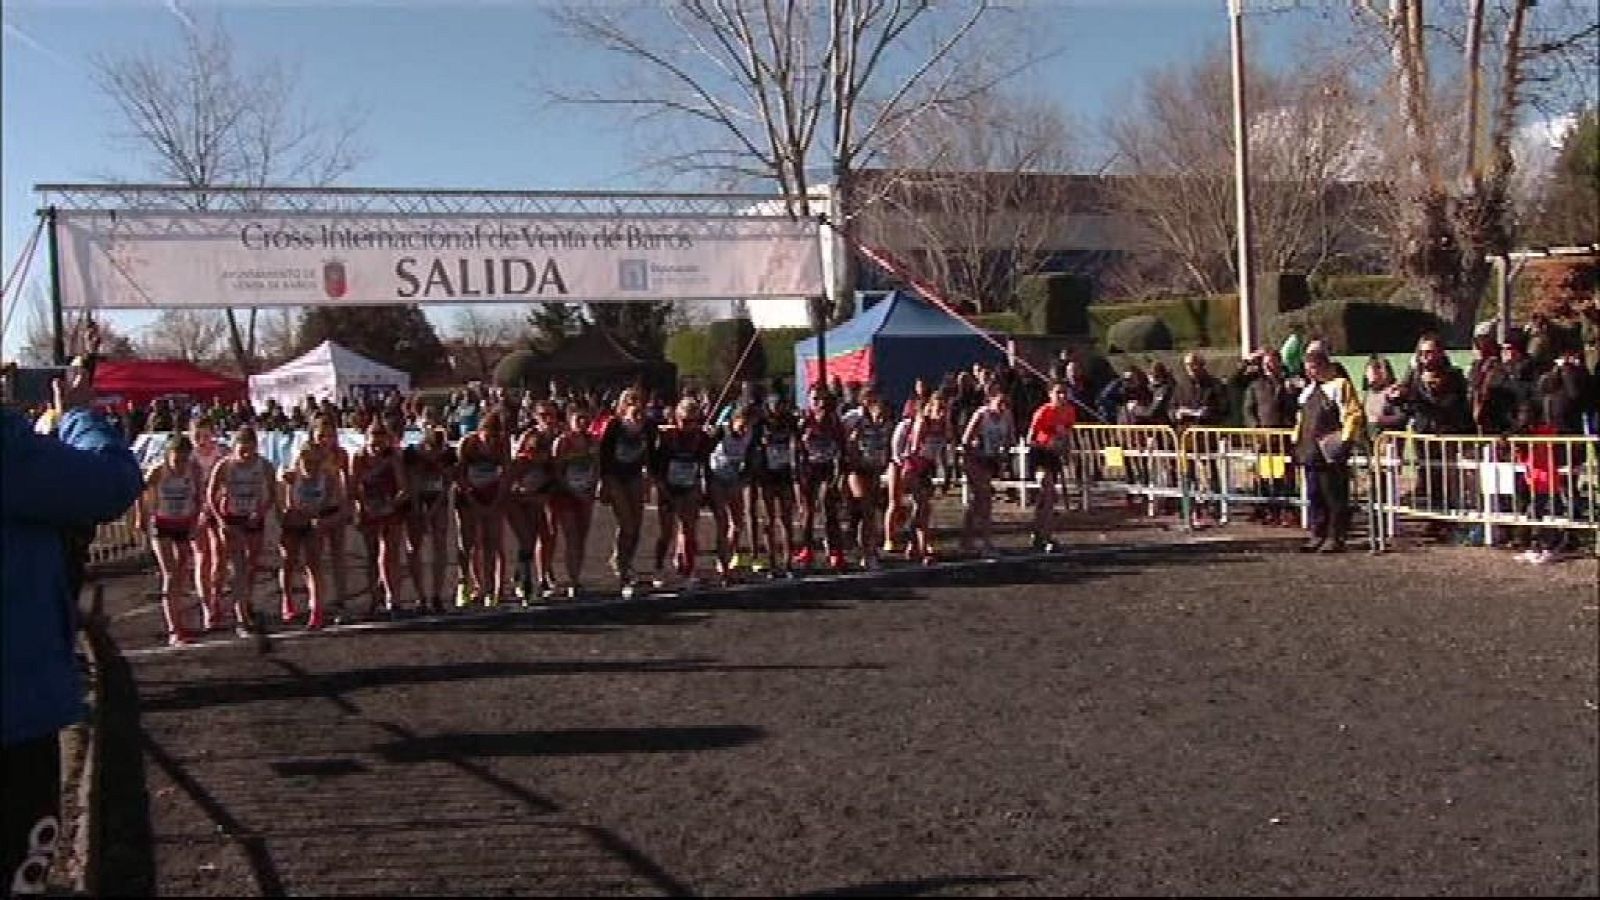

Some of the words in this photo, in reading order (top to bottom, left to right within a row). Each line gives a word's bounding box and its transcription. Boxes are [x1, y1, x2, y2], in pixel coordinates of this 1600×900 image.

[241, 223, 315, 250] Cross
[321, 223, 482, 250] Internacional
[488, 223, 519, 250] de
[521, 224, 586, 250] Venta
[593, 222, 622, 250] de
[395, 256, 568, 298] SALIDA
